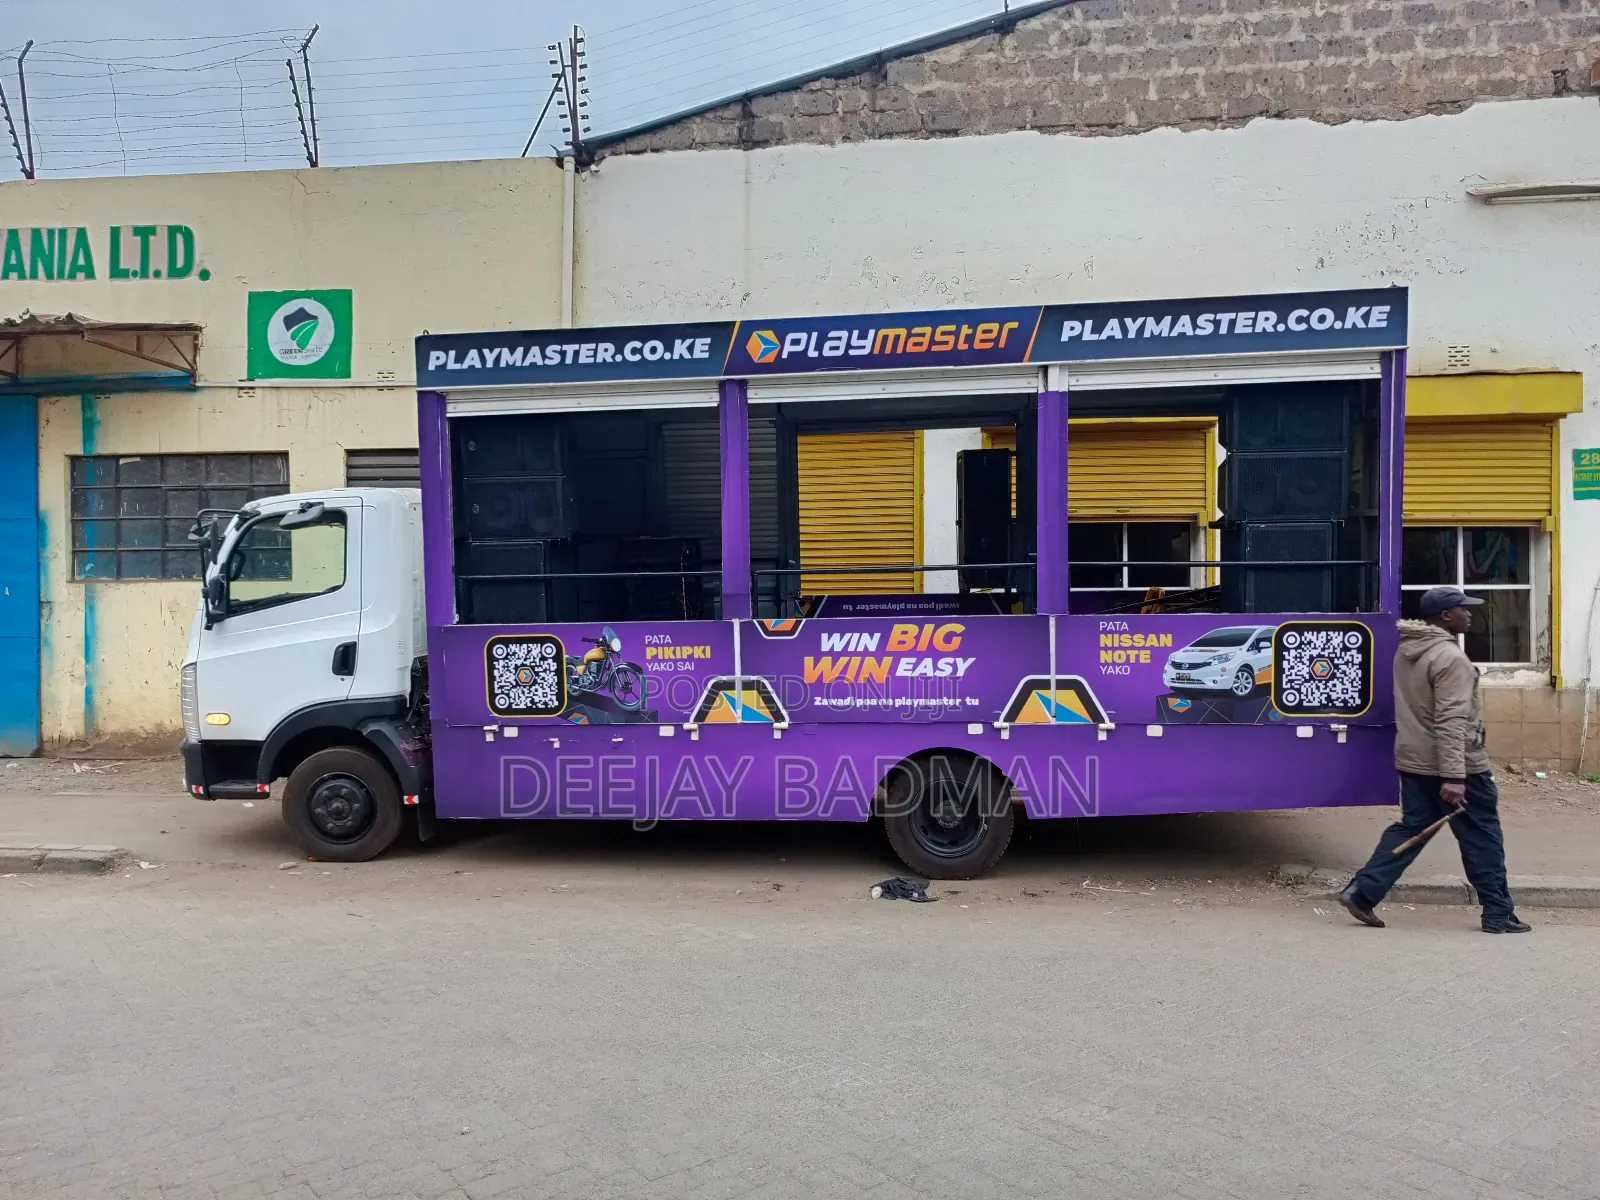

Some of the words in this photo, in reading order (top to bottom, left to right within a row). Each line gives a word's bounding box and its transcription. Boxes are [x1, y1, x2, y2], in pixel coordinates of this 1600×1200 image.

[1060, 305, 1391, 342] PLAYMASTER.CO.KE
[427, 337, 712, 371] PLAYMASTER.CO.KE
[1099, 621, 1129, 631] PATA
[645, 635, 672, 644] PATA
[820, 632, 881, 652] WIN
[885, 623, 966, 652] BIG
[1100, 633, 1173, 647] NISSAN
[646, 646, 711, 659] PIKIPKI
[1100, 650, 1151, 664] NOTE
[646, 662, 674, 671] YAKO
[677, 661, 694, 671] SAI
[803, 656, 893, 684] WIN
[895, 657, 976, 676] EASY
[1100, 665, 1131, 675] YAKO
[813, 696, 855, 706] Zawadi
[856, 699, 876, 708] poa
[895, 697, 962, 708] playmaster
[965, 697, 980, 706] tu
